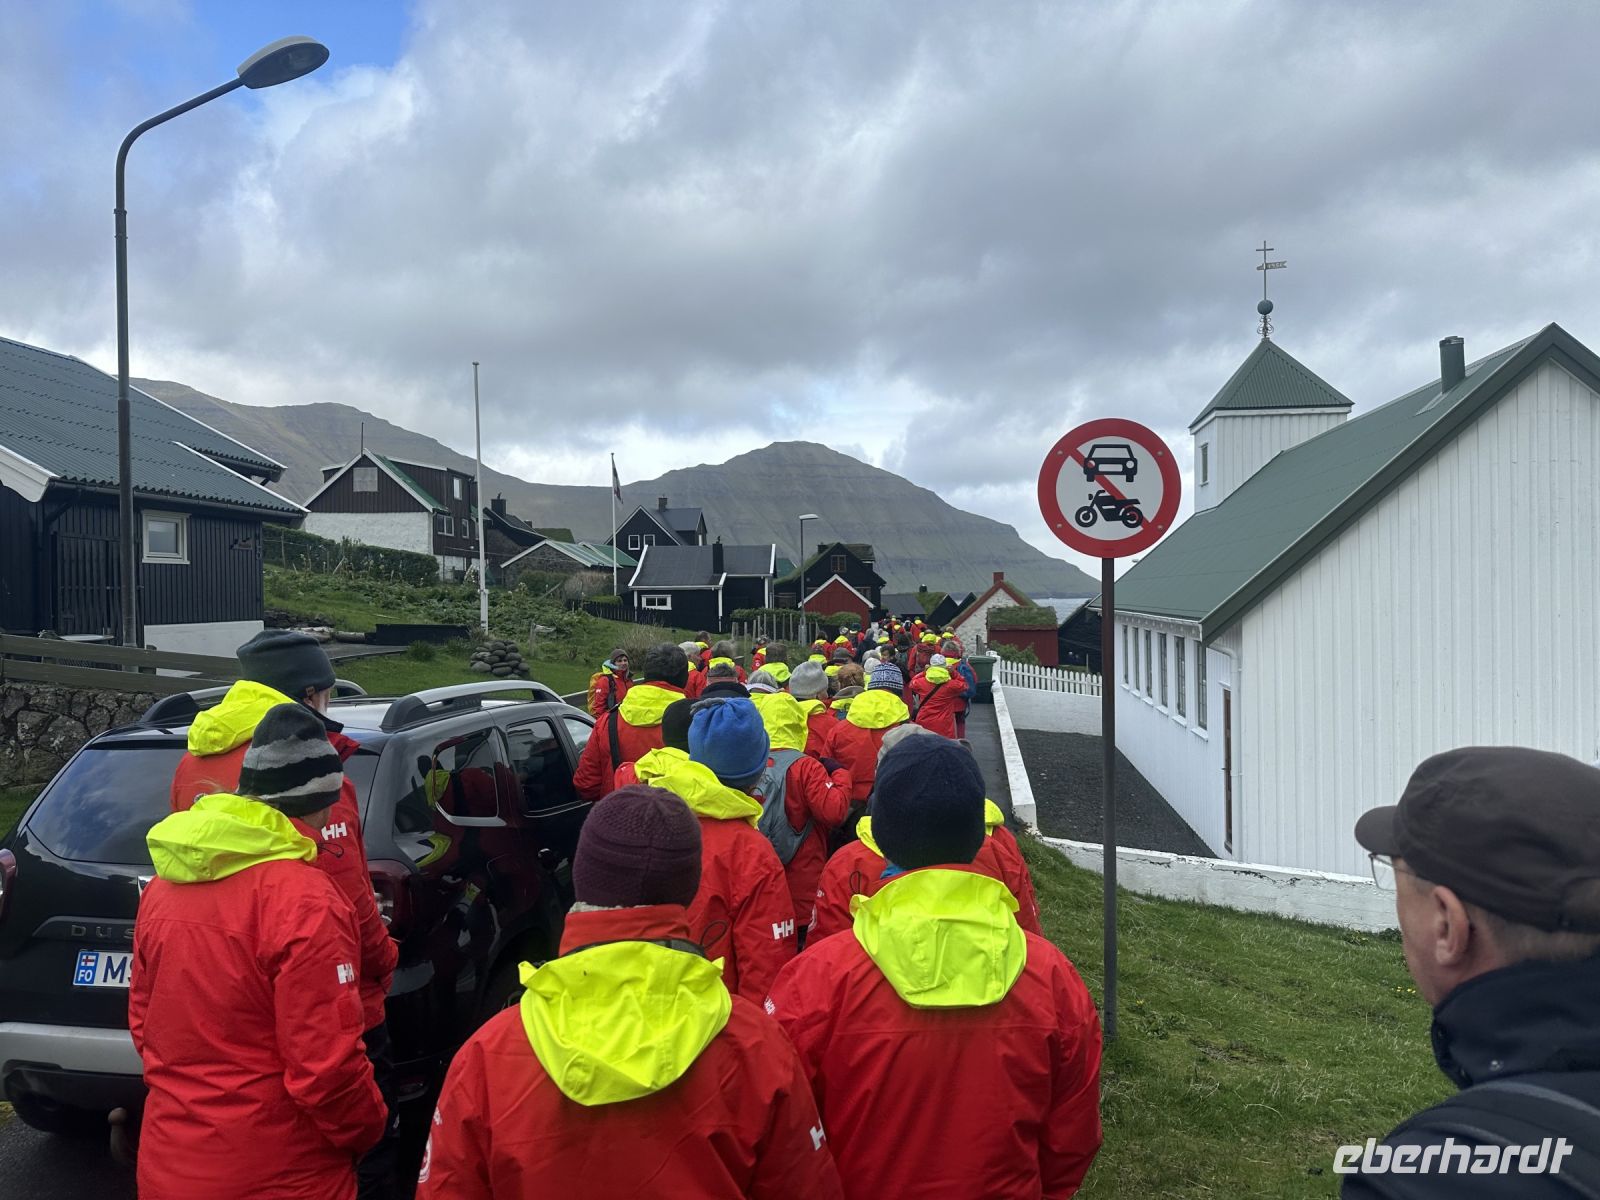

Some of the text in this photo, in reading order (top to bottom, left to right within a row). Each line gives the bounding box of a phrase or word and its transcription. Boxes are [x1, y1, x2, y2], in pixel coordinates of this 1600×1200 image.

[321, 822, 347, 840] HH
[772, 918, 794, 940] HH
[78, 969, 93, 982] FO
